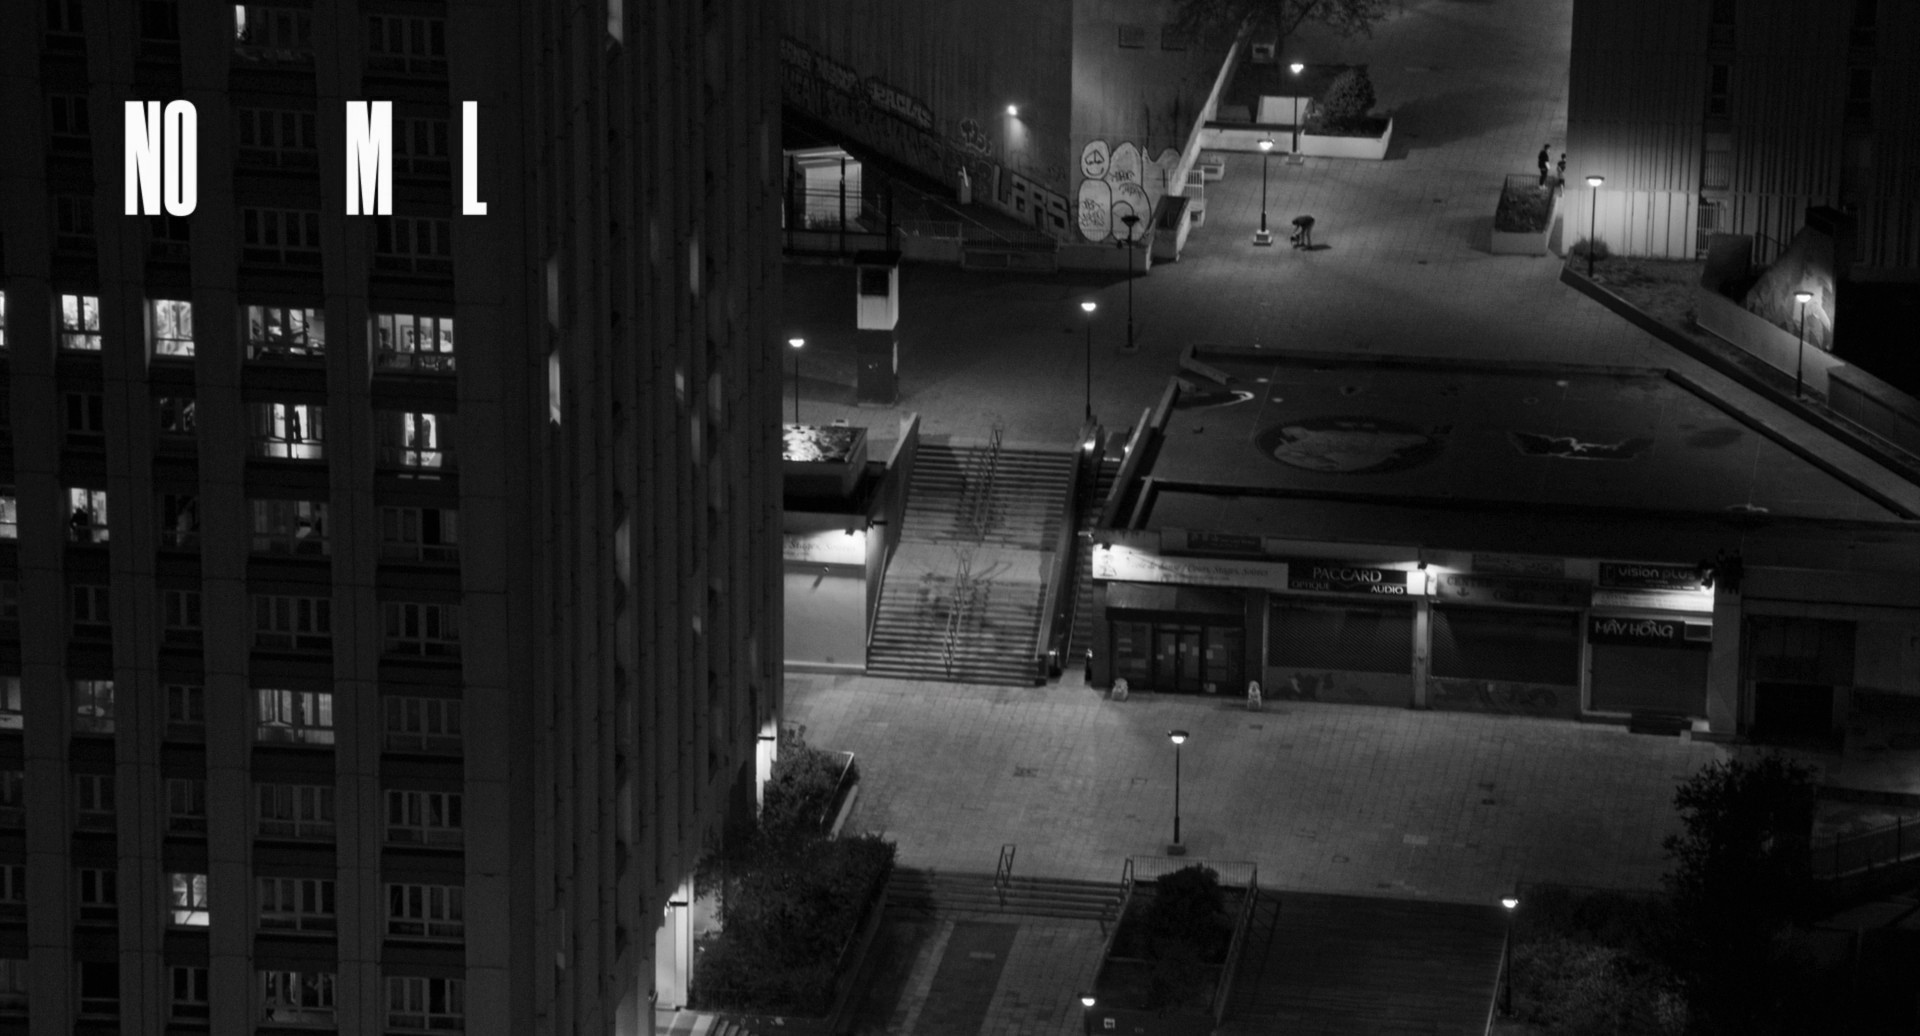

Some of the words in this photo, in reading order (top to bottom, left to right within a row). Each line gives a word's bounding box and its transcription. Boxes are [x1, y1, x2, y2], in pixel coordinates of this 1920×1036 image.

[1312, 567, 1382, 582] PACCARD
[1618, 565, 1659, 578] vision
[1370, 584, 1404, 595] AUDIO
